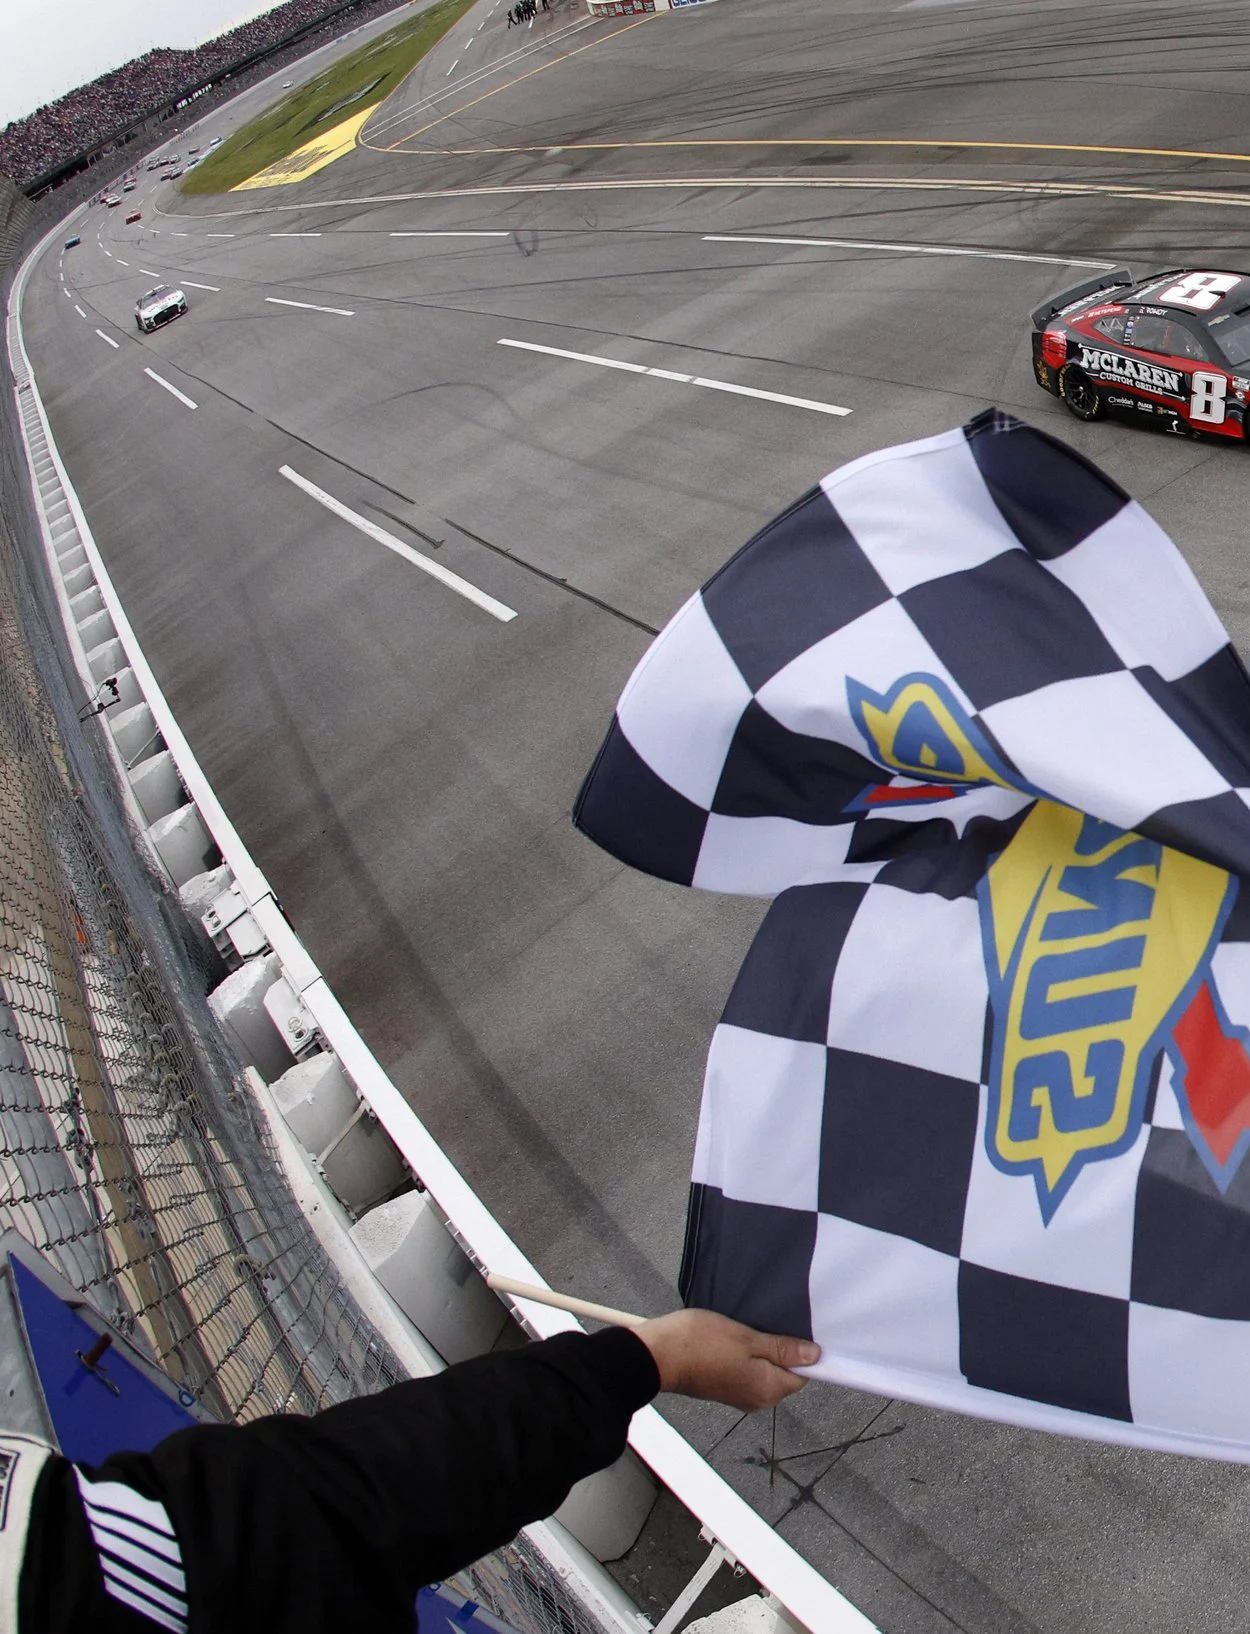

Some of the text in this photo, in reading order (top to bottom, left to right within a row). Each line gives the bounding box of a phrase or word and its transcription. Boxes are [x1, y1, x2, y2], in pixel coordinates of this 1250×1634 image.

[1160, 272, 1242, 309] 8
[1080, 348, 1180, 392] MCLAREN
[1100, 371, 1164, 395] CUSTOM GRILLS
[1190, 371, 1228, 424] 8
